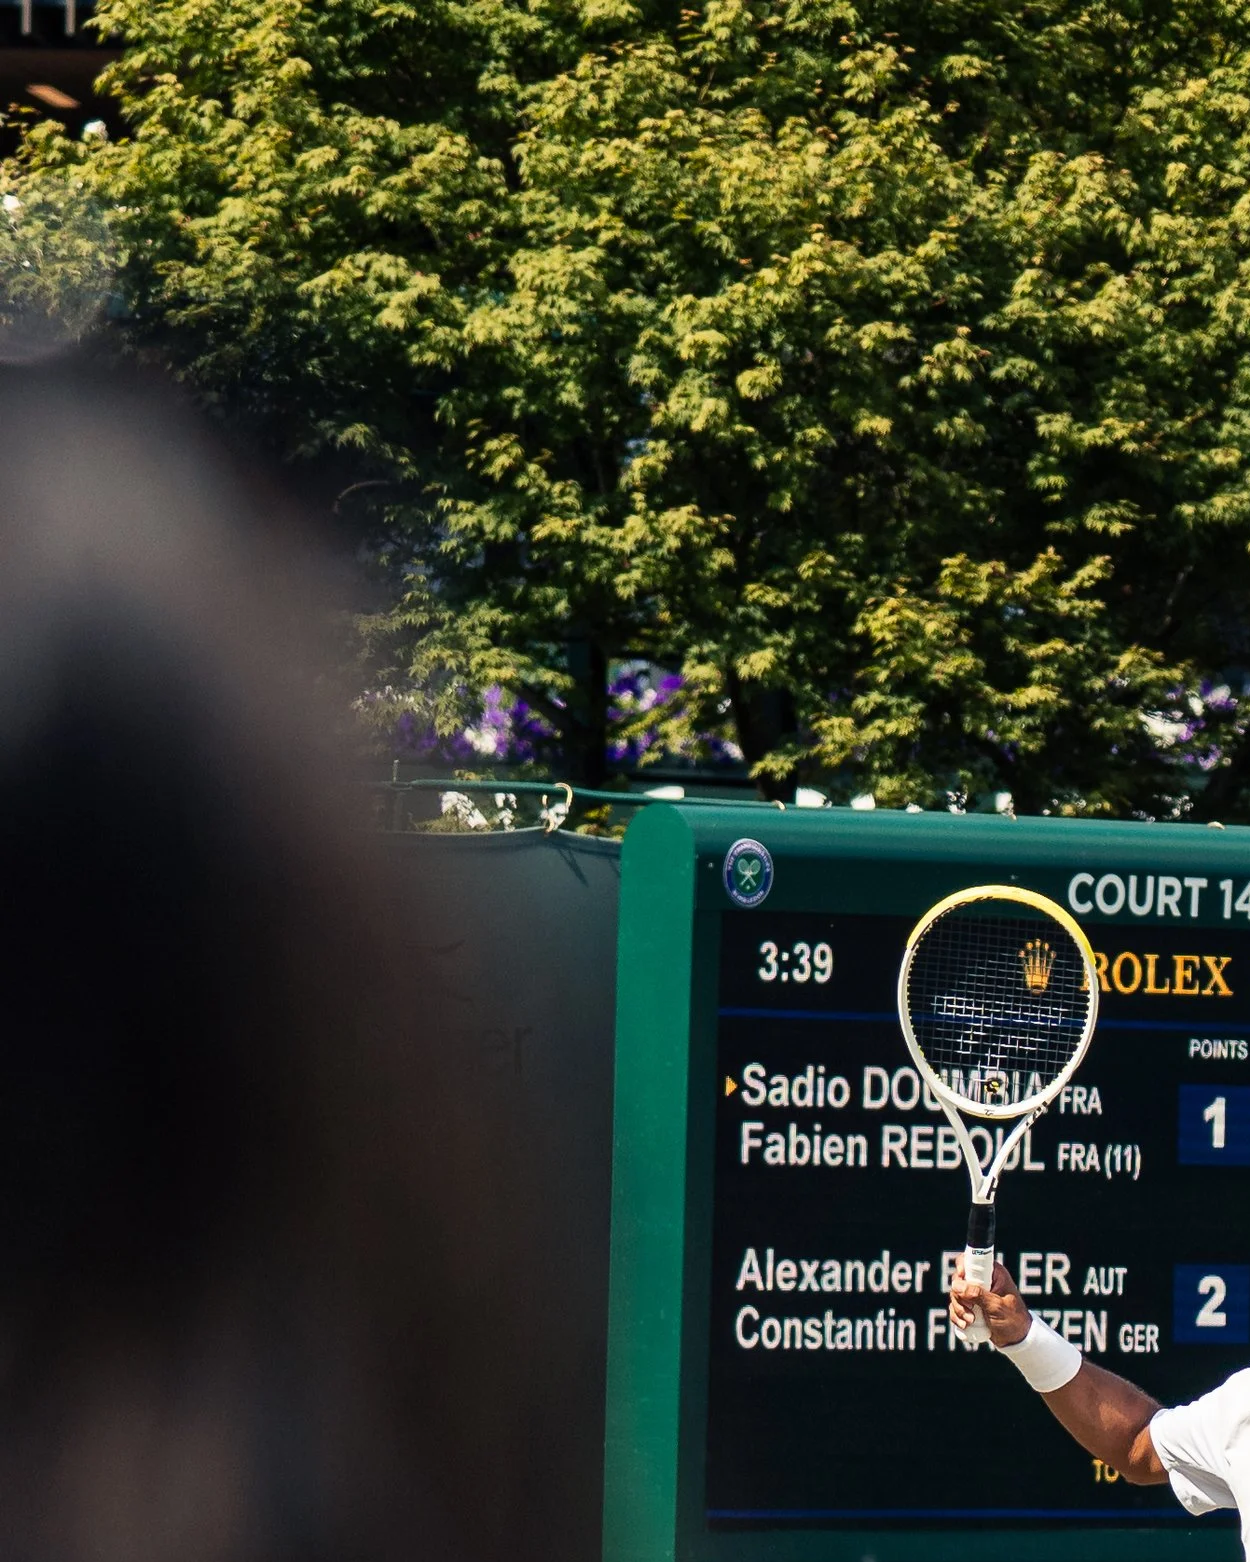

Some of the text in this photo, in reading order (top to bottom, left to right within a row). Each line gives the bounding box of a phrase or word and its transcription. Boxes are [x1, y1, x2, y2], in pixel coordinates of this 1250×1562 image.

[1068, 873, 1208, 919] COURT
[758, 941, 833, 984] 3:39
[1080, 951, 1234, 997] ROLEX
[1189, 1038, 1249, 1061] POINTS
[741, 1062, 851, 1108] Sadio
[1059, 1086, 1103, 1116] FRA
[1203, 1095, 1227, 1149] 1
[740, 1121, 868, 1167] Fabien
[1057, 1143, 1101, 1173] FRA
[1105, 1144, 1142, 1181] (11)
[735, 1247, 1128, 1296] Alexander EER AUT
[1195, 1274, 1227, 1327] 2
[735, 1304, 916, 1351] Constantin
[1118, 1323, 1160, 1353] GER
